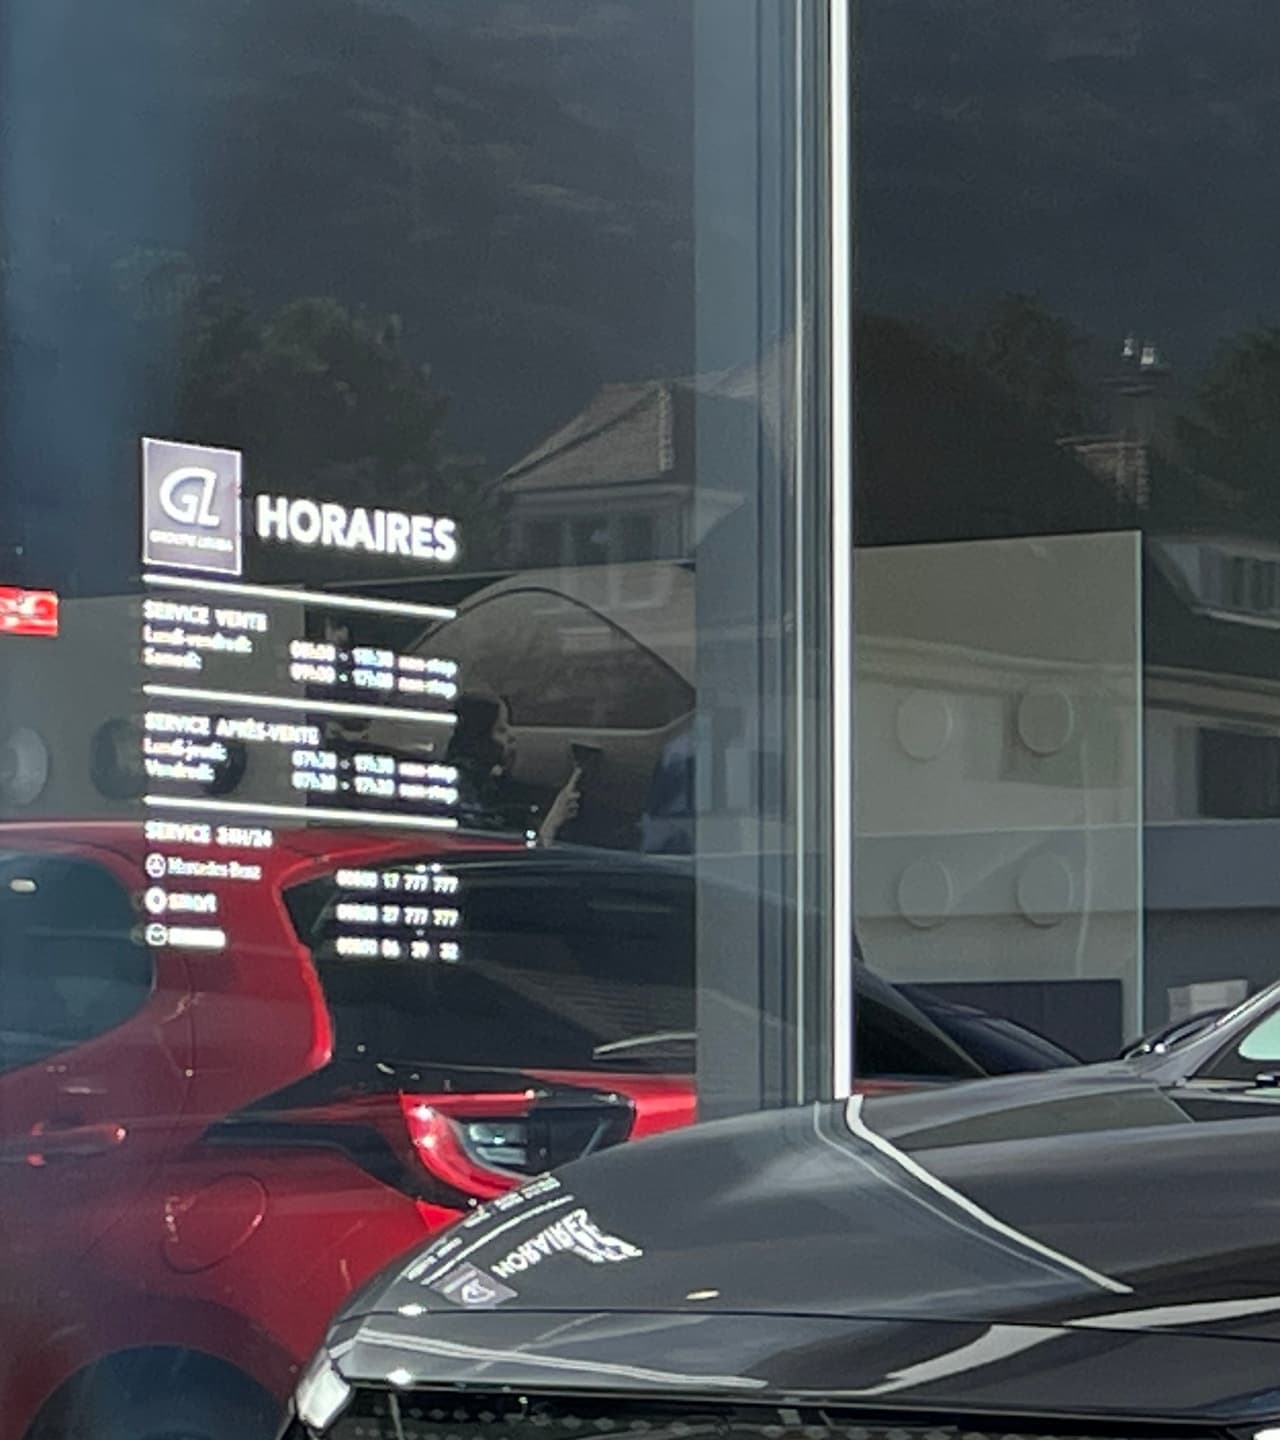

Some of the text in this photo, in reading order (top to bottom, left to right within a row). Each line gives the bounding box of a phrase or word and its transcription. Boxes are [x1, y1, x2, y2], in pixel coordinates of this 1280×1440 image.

[159, 467, 220, 527] GL
[256, 494, 457, 563] HORAIRES
[143, 599, 268, 632] SERVICE VENTE
[144, 711, 211, 736] SERVICE
[144, 820, 212, 844] SERVICE
[167, 856, 262, 881] Mercedes-Benz
